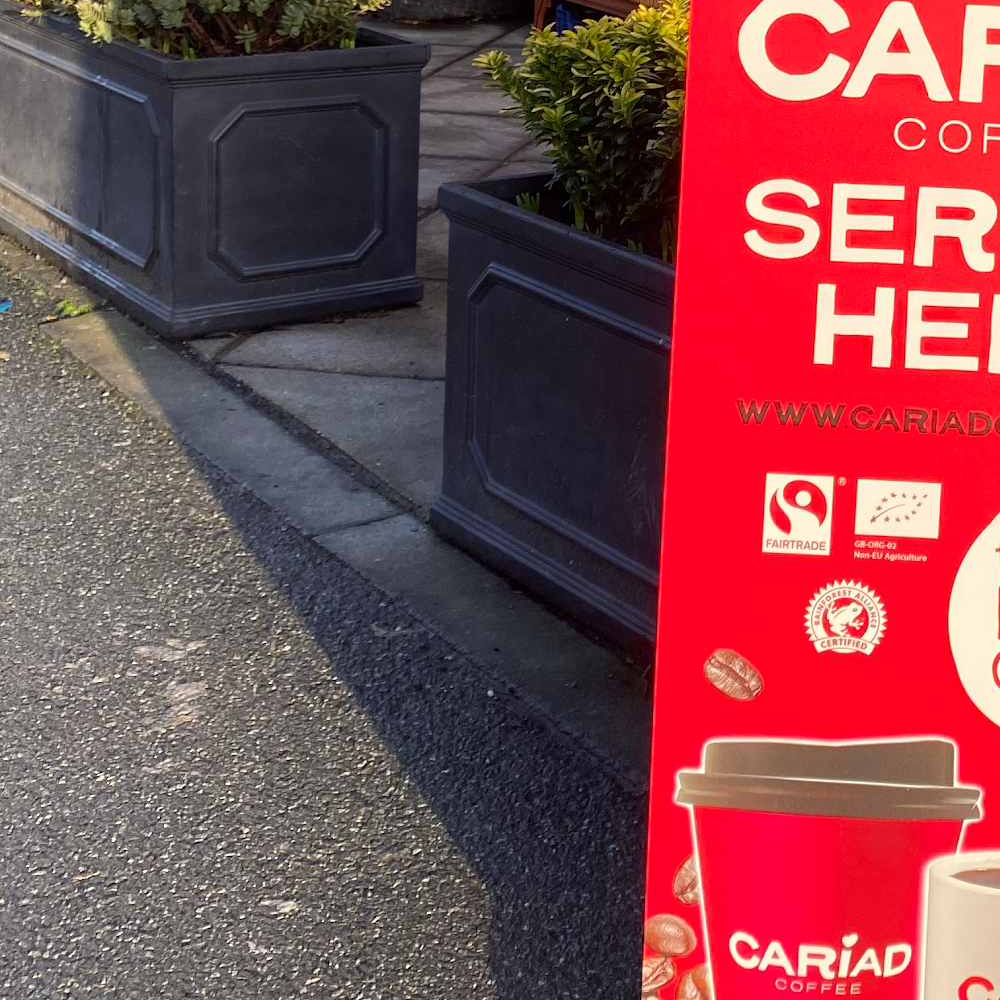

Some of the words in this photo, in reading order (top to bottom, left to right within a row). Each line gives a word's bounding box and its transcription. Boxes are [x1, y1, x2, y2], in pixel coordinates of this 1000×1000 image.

[765, 538, 827, 551] FAIRTRADE
[854, 540, 897, 550] GB-ORG-02
[853, 550, 883, 560] Non-EU
[884, 552, 928, 562] Agriculture
[814, 589, 852, 626] RAINFOREST
[855, 592, 877, 629] ALLIANCE
[820, 638, 868, 651] CERTIFIED
[774, 977, 862, 995] COFFEE
